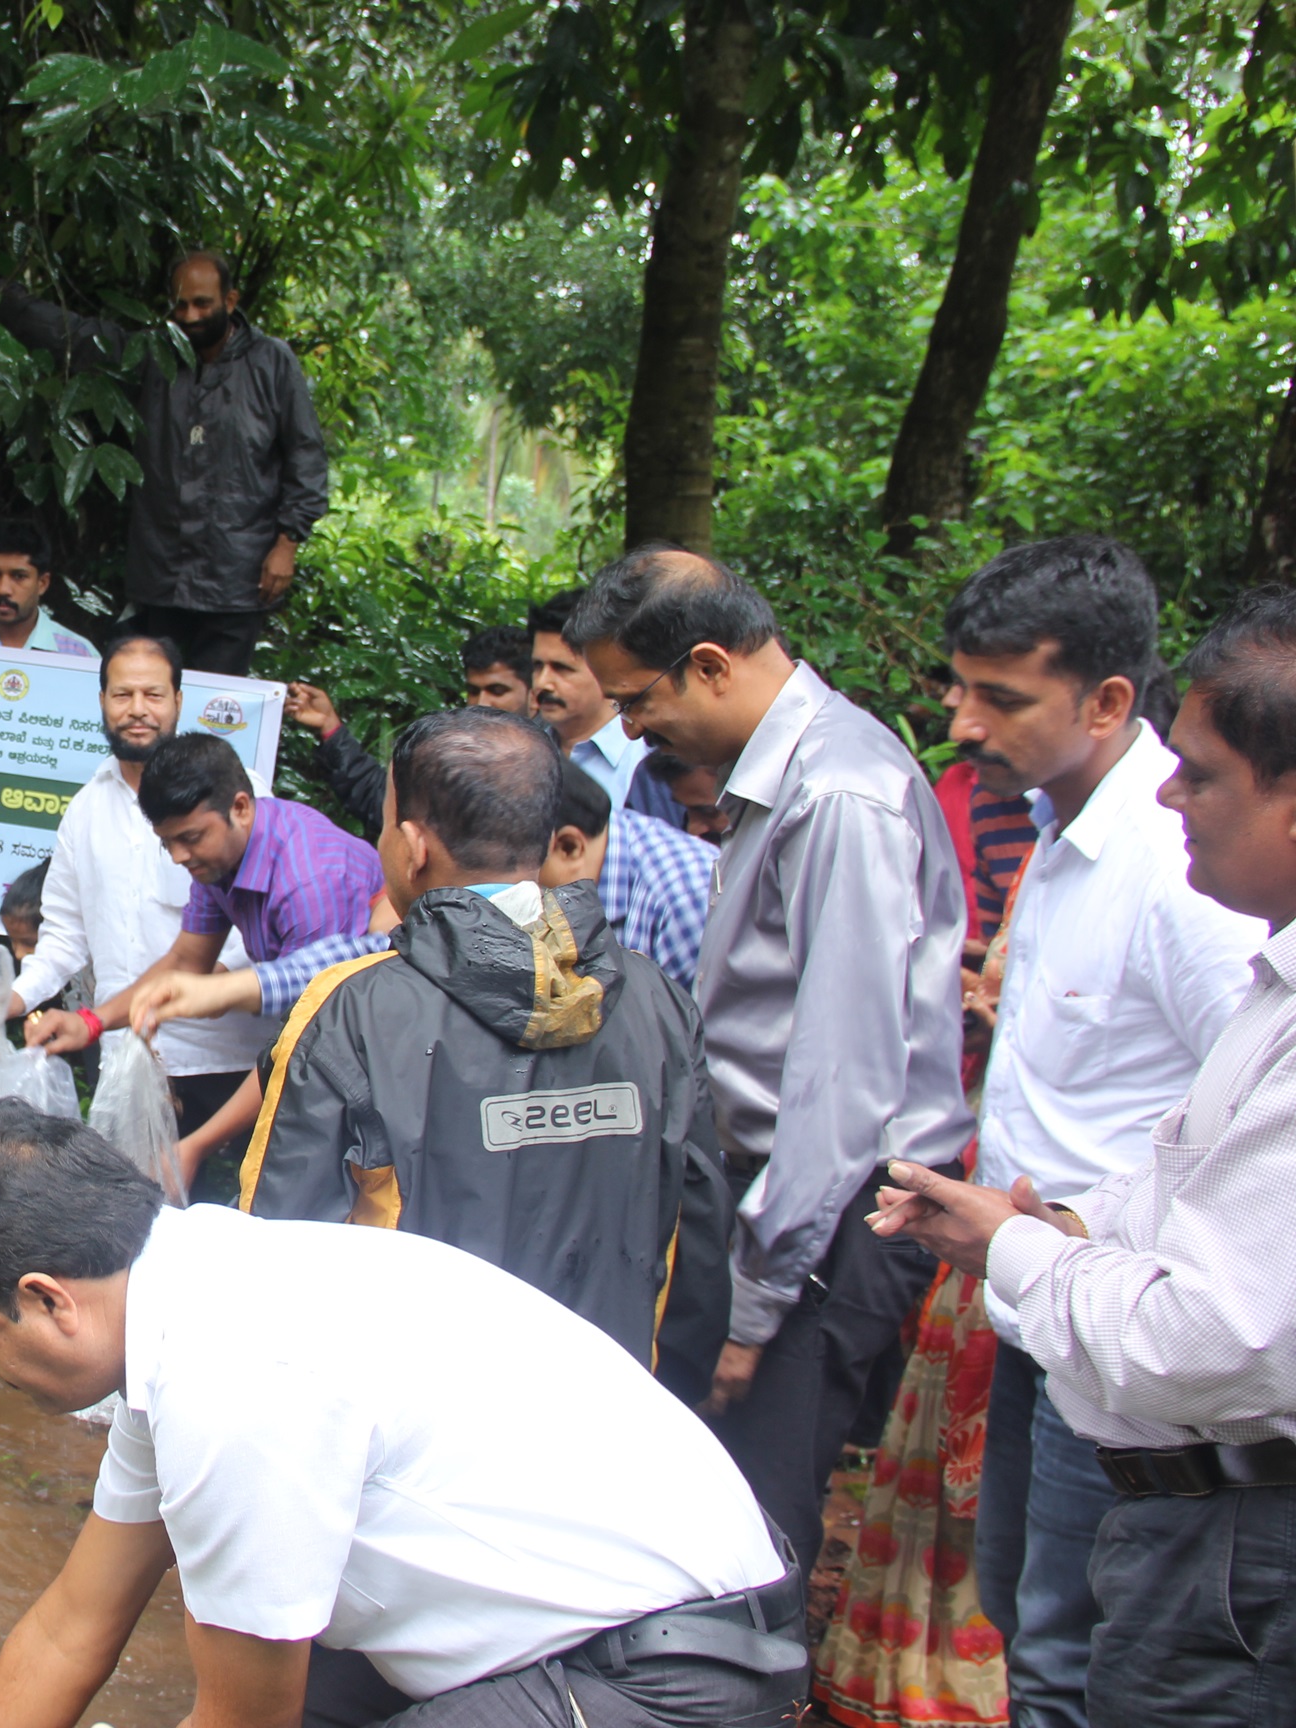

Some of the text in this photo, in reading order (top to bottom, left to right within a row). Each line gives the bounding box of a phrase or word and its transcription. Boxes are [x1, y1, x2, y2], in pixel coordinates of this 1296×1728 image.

[18, 712, 64, 728] ಪಿಲಿಕುಳ
[32, 736, 54, 750] ಮತ್ತು
[8, 752, 58, 770] ಆಶ್ರಯದಲ್ಲಿ
